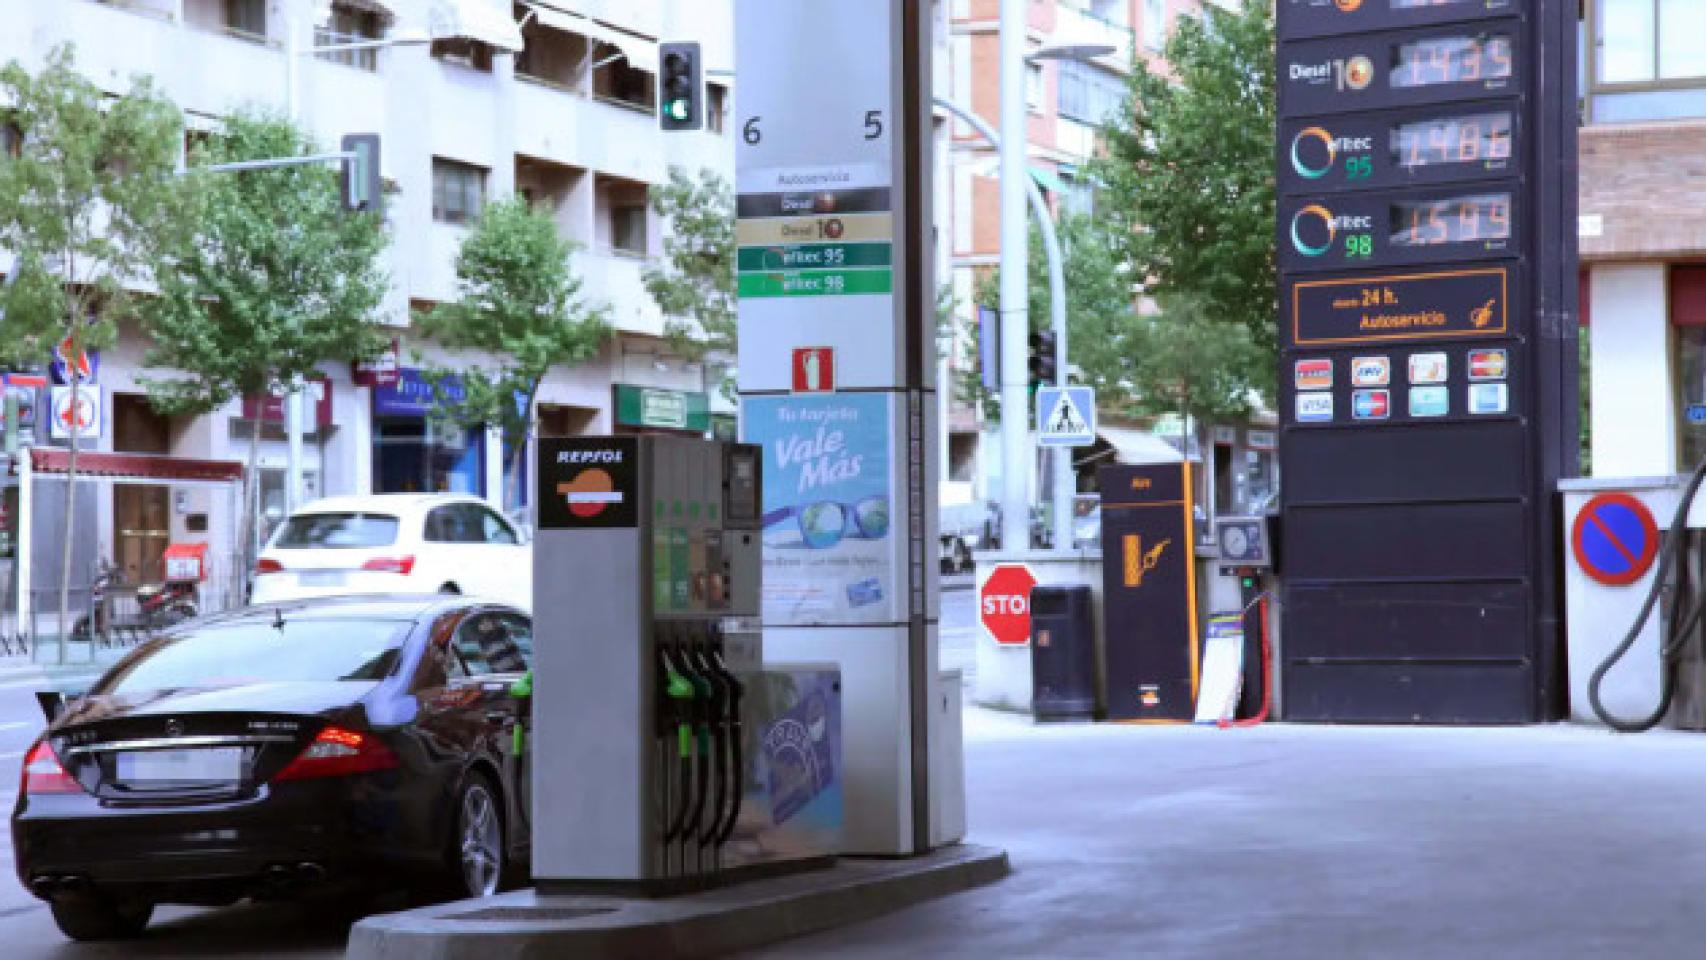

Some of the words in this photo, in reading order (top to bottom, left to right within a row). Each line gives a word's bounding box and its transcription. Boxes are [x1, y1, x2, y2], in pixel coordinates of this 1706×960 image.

[1289, 61, 1331, 80] Diesel
[743, 115, 762, 146] 6
[864, 109, 883, 140] 5
[778, 170, 850, 185] Autoservicio
[1345, 155, 1373, 179] 95
[824, 248, 844, 264] 95
[1345, 233, 1373, 257] 98
[1360, 311, 1447, 330] Autoservicio
[776, 407, 796, 422] Tu
[800, 405, 859, 425] tarjeta
[556, 451, 623, 463] REPSOL
[775, 426, 844, 469] Vale
[798, 450, 864, 493] Más
[983, 594, 1030, 616] STO
